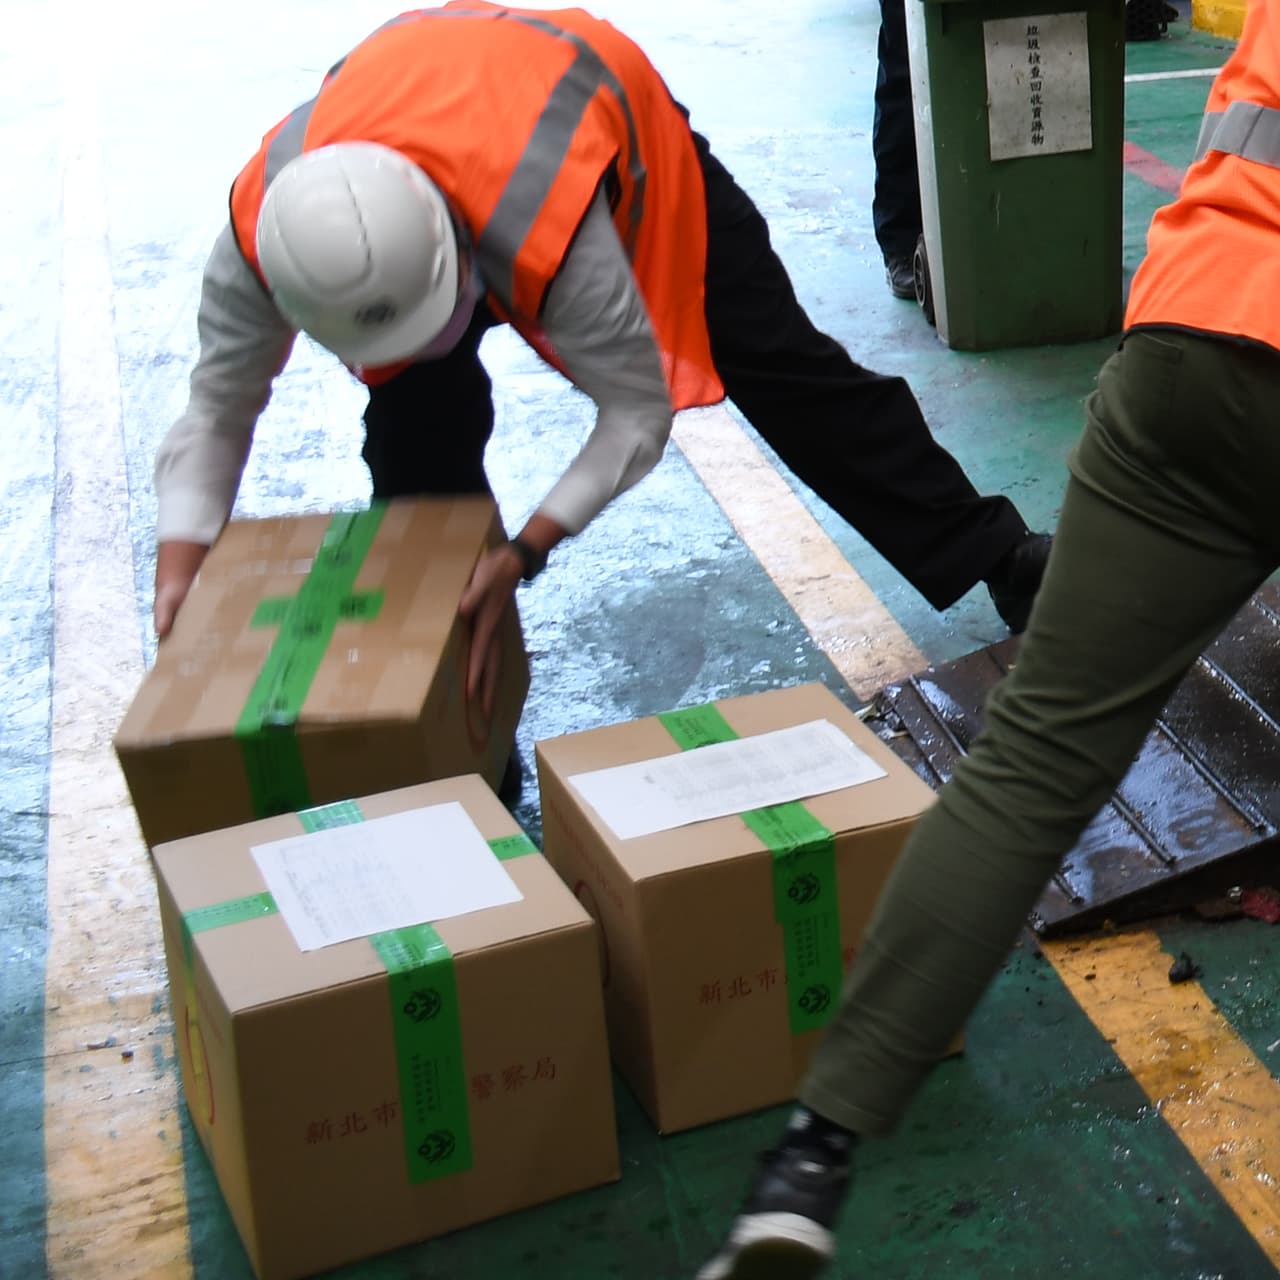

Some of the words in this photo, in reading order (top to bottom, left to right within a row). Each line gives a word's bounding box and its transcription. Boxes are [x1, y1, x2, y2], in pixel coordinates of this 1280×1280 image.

[304, 1056, 557, 1145] 新北市警察局
